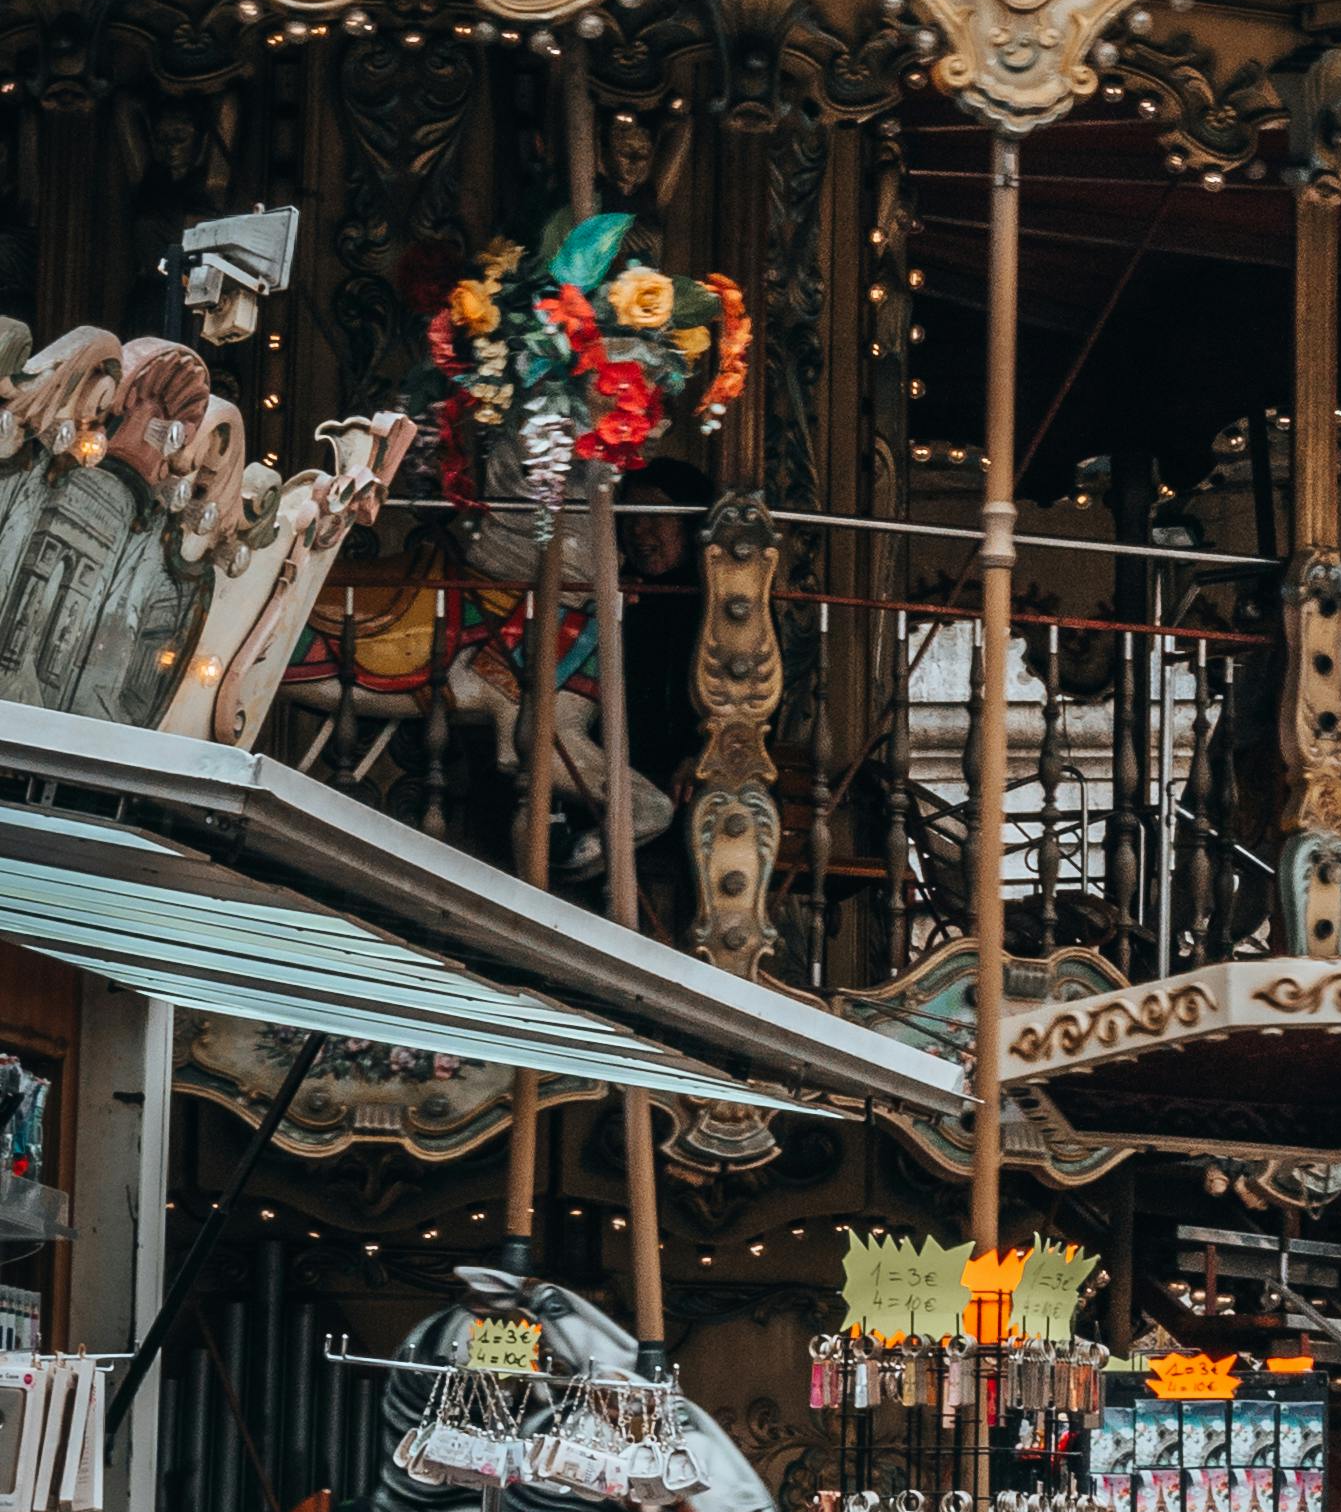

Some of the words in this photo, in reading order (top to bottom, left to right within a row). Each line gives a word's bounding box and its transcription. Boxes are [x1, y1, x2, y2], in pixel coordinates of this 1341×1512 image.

[869, 1261, 882, 1284] 1
[873, 1290, 884, 1311] 4
[476, 1349, 486, 1365] 4
